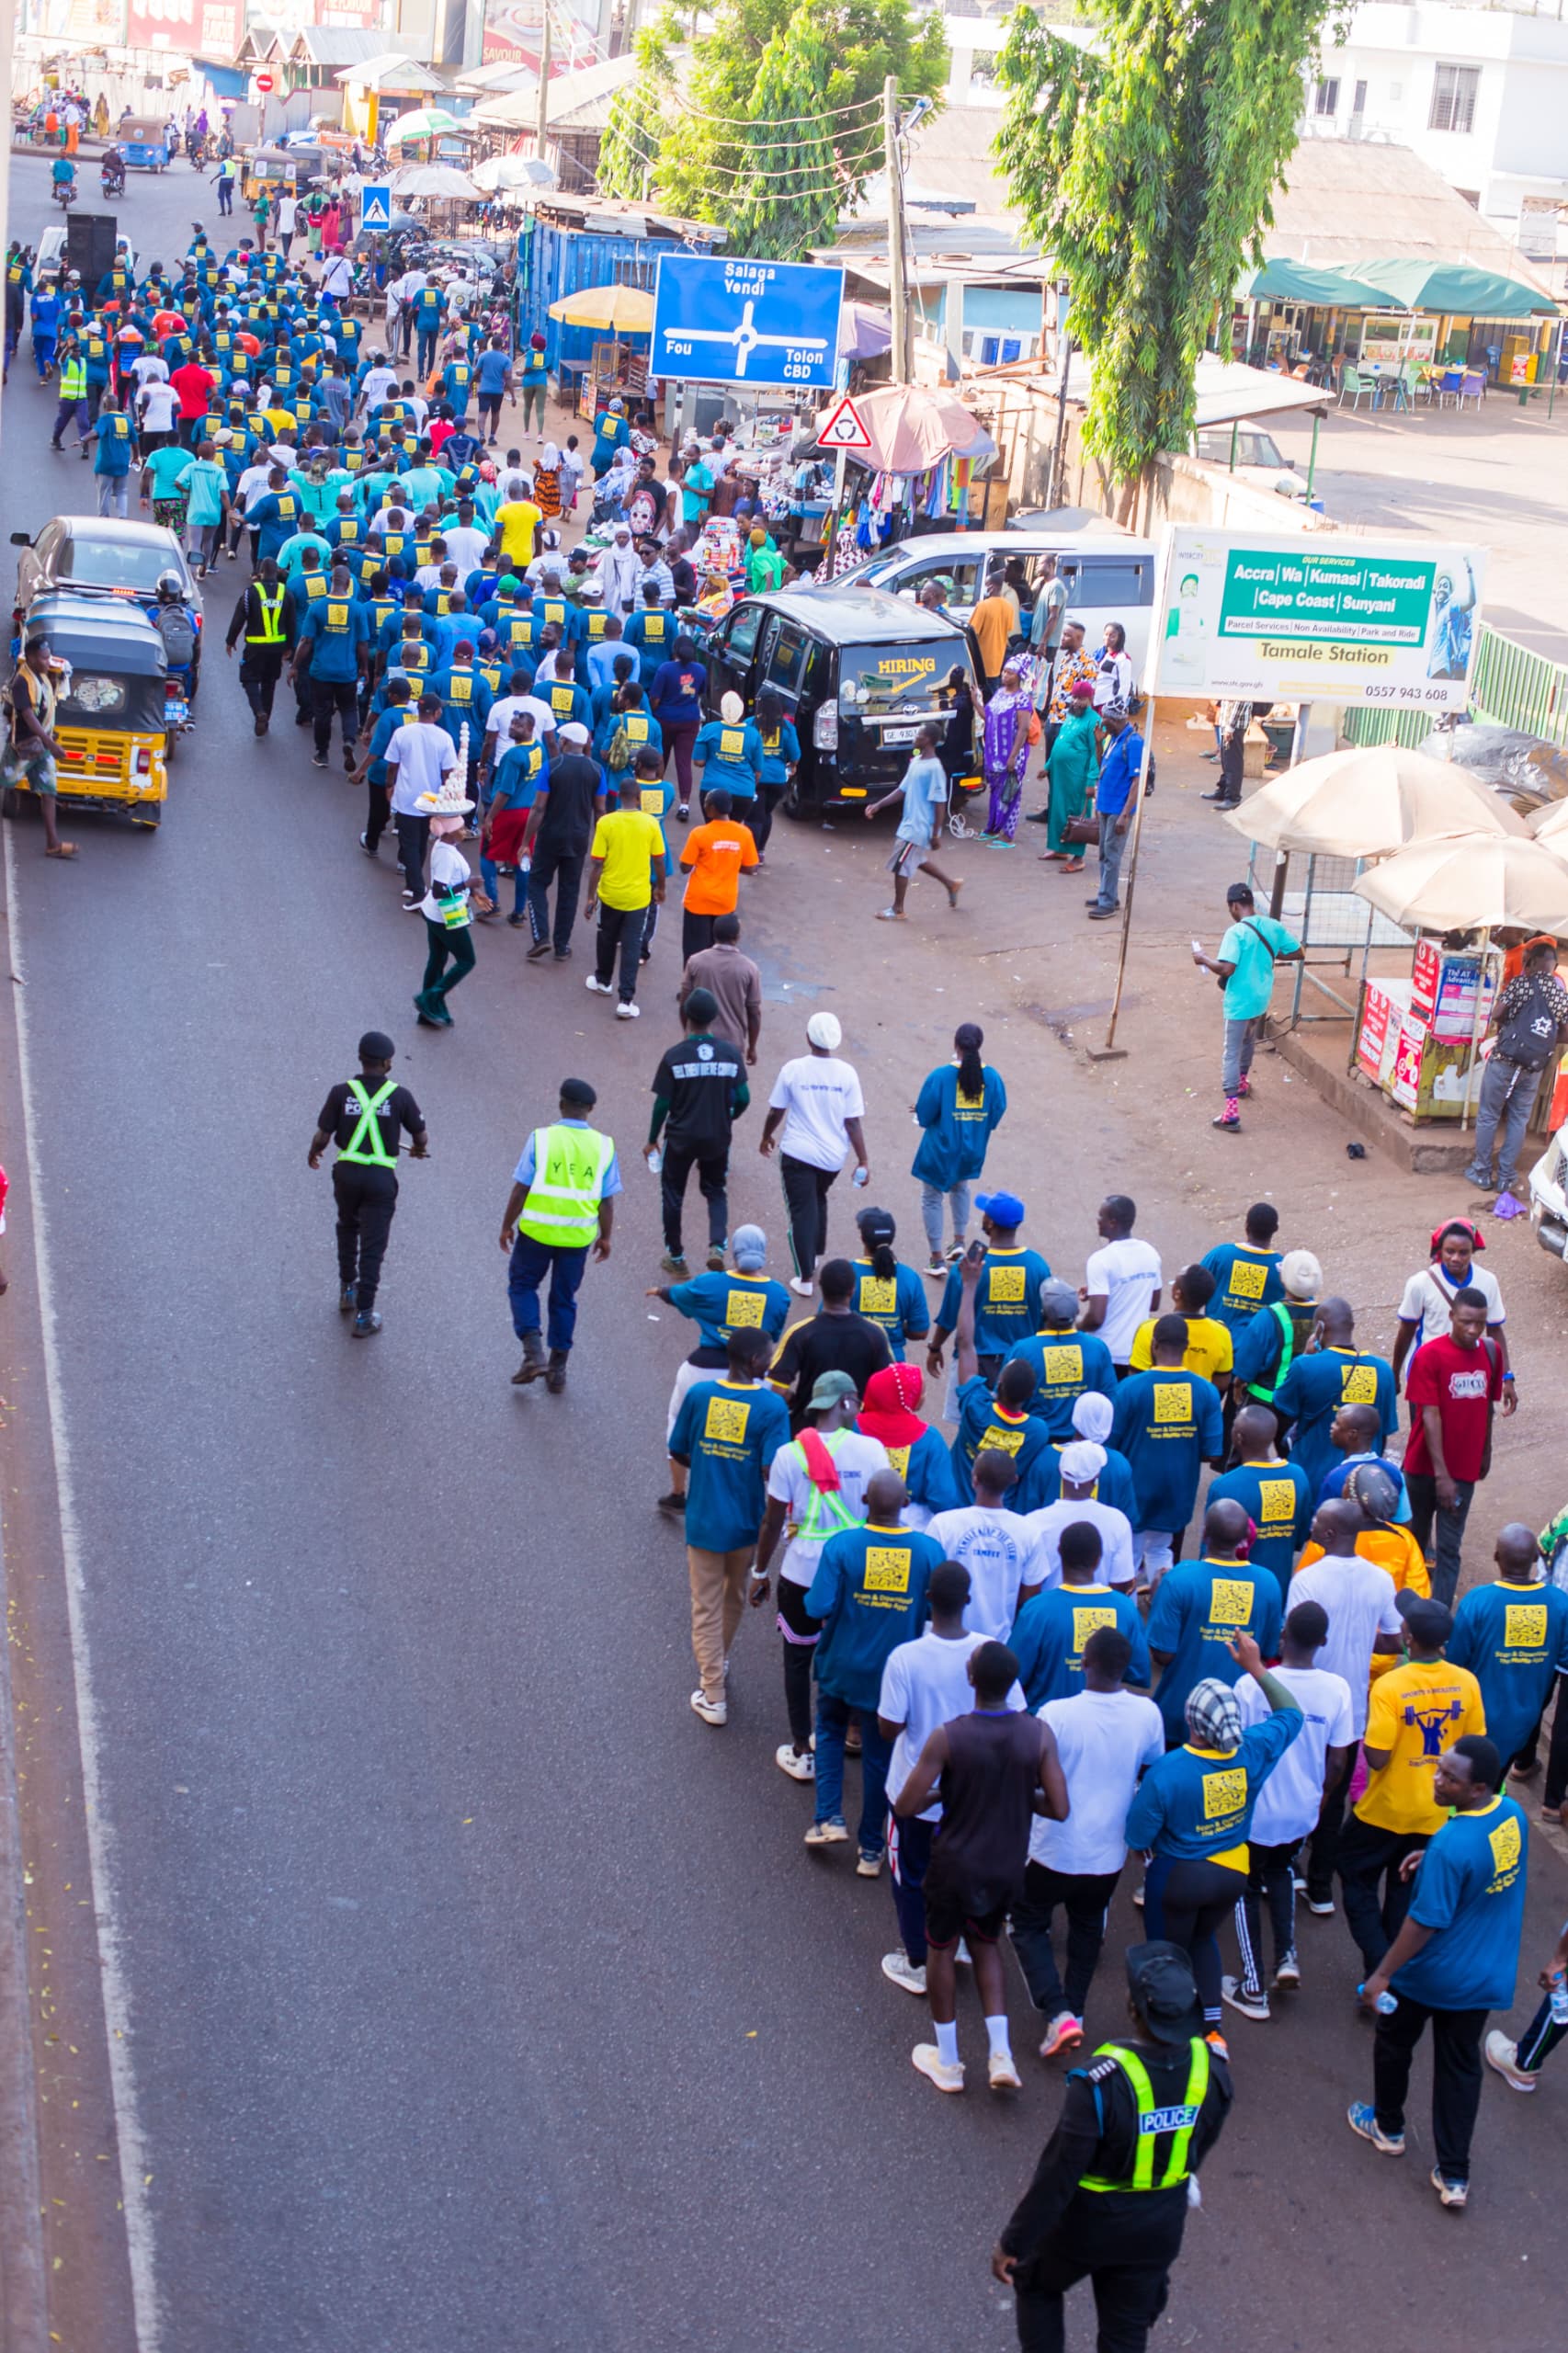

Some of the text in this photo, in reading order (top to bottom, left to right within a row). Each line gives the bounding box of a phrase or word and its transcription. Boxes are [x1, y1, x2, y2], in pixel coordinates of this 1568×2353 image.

[483, 48, 522, 62] SAVOUR
[724, 262, 776, 282] Salaga
[724, 279, 765, 296] Yendi
[665, 340, 692, 355] Fou
[786, 348, 824, 364] Tolon
[783, 364, 812, 379] CBD
[1301, 555, 1357, 567] OUR SERVICES
[1233, 563, 1426, 590] Accra Wa Kumasi Takoradi
[1258, 590, 1396, 615] Cape Coast Sunyani
[1227, 620, 1416, 639] Parcel Services Non Availability Park and Ride
[1260, 642, 1390, 665] Tamale Station
[878, 657, 936, 674] HIRING
[1366, 685, 1395, 699] 0557
[1399, 687, 1422, 699] 943
[1425, 688, 1449, 701] 608
[1460, 969, 1471, 977] AT
[1144, 2109, 1194, 2131] POLICE
